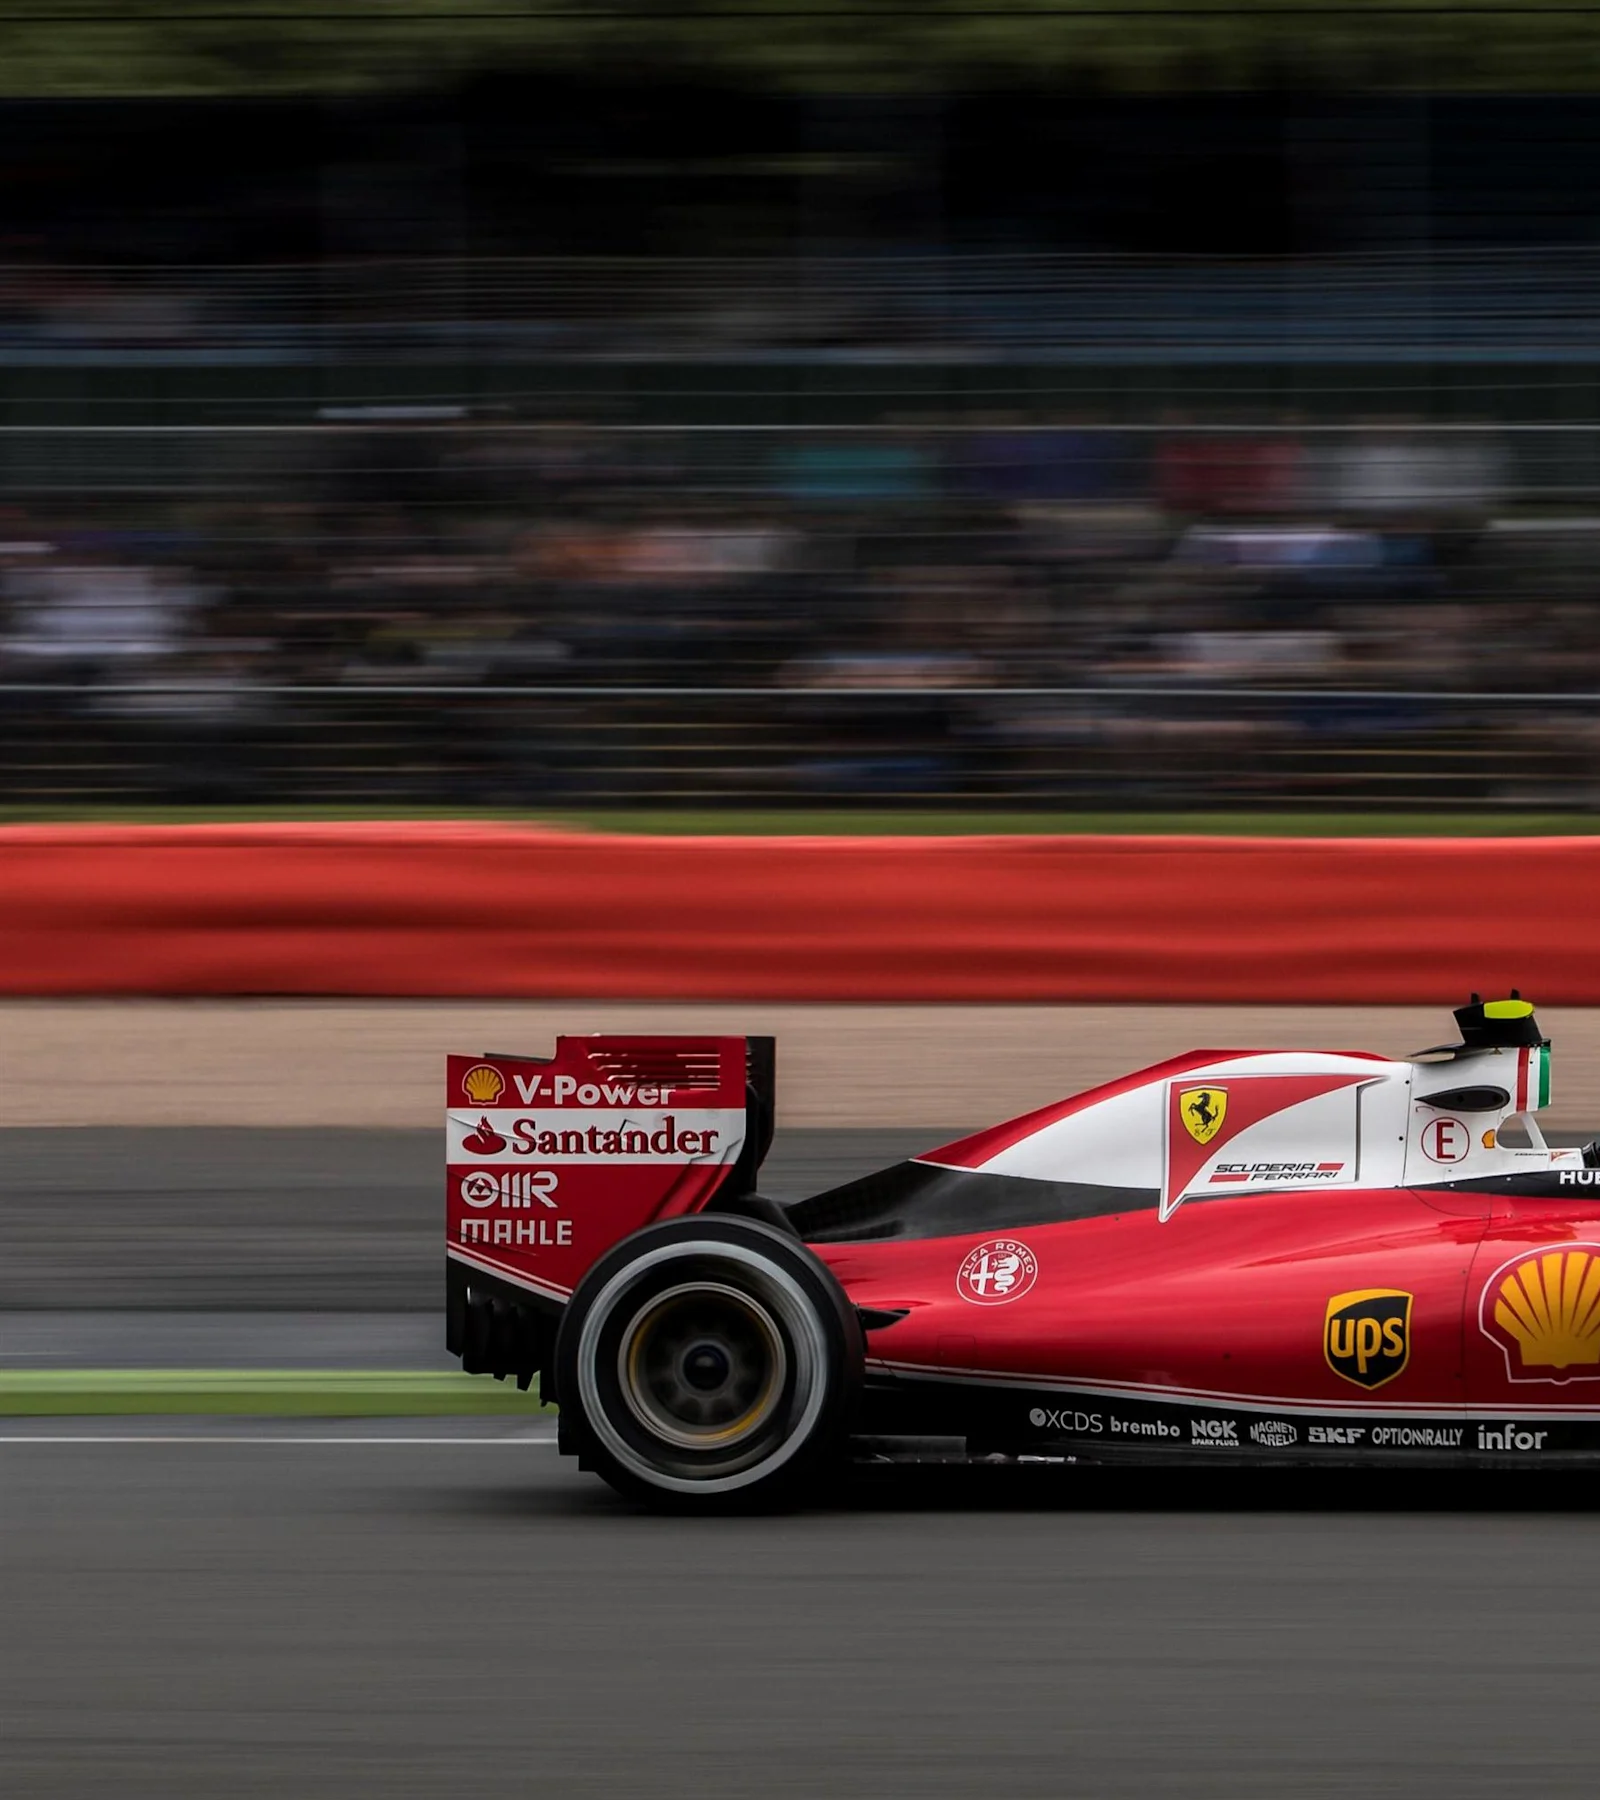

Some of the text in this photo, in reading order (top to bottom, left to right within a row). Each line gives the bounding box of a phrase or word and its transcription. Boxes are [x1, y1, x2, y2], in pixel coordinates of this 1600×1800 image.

[513, 1075, 676, 1105] V-Power
[512, 1115, 719, 1155] Santander
[1436, 1122, 1456, 1159] E
[1214, 1163, 1316, 1173] SCUDERIA
[1251, 1172, 1338, 1181] FERRARI
[461, 1219, 573, 1245] MAHLE
[961, 1242, 1034, 1278] ALFA ROMEO
[1330, 1317, 1404, 1374] ups
[1110, 1416, 1180, 1437] brembo
[1191, 1419, 1238, 1438] NGK
[1308, 1426, 1365, 1444] SKF
[1478, 1423, 1548, 1450] infor
